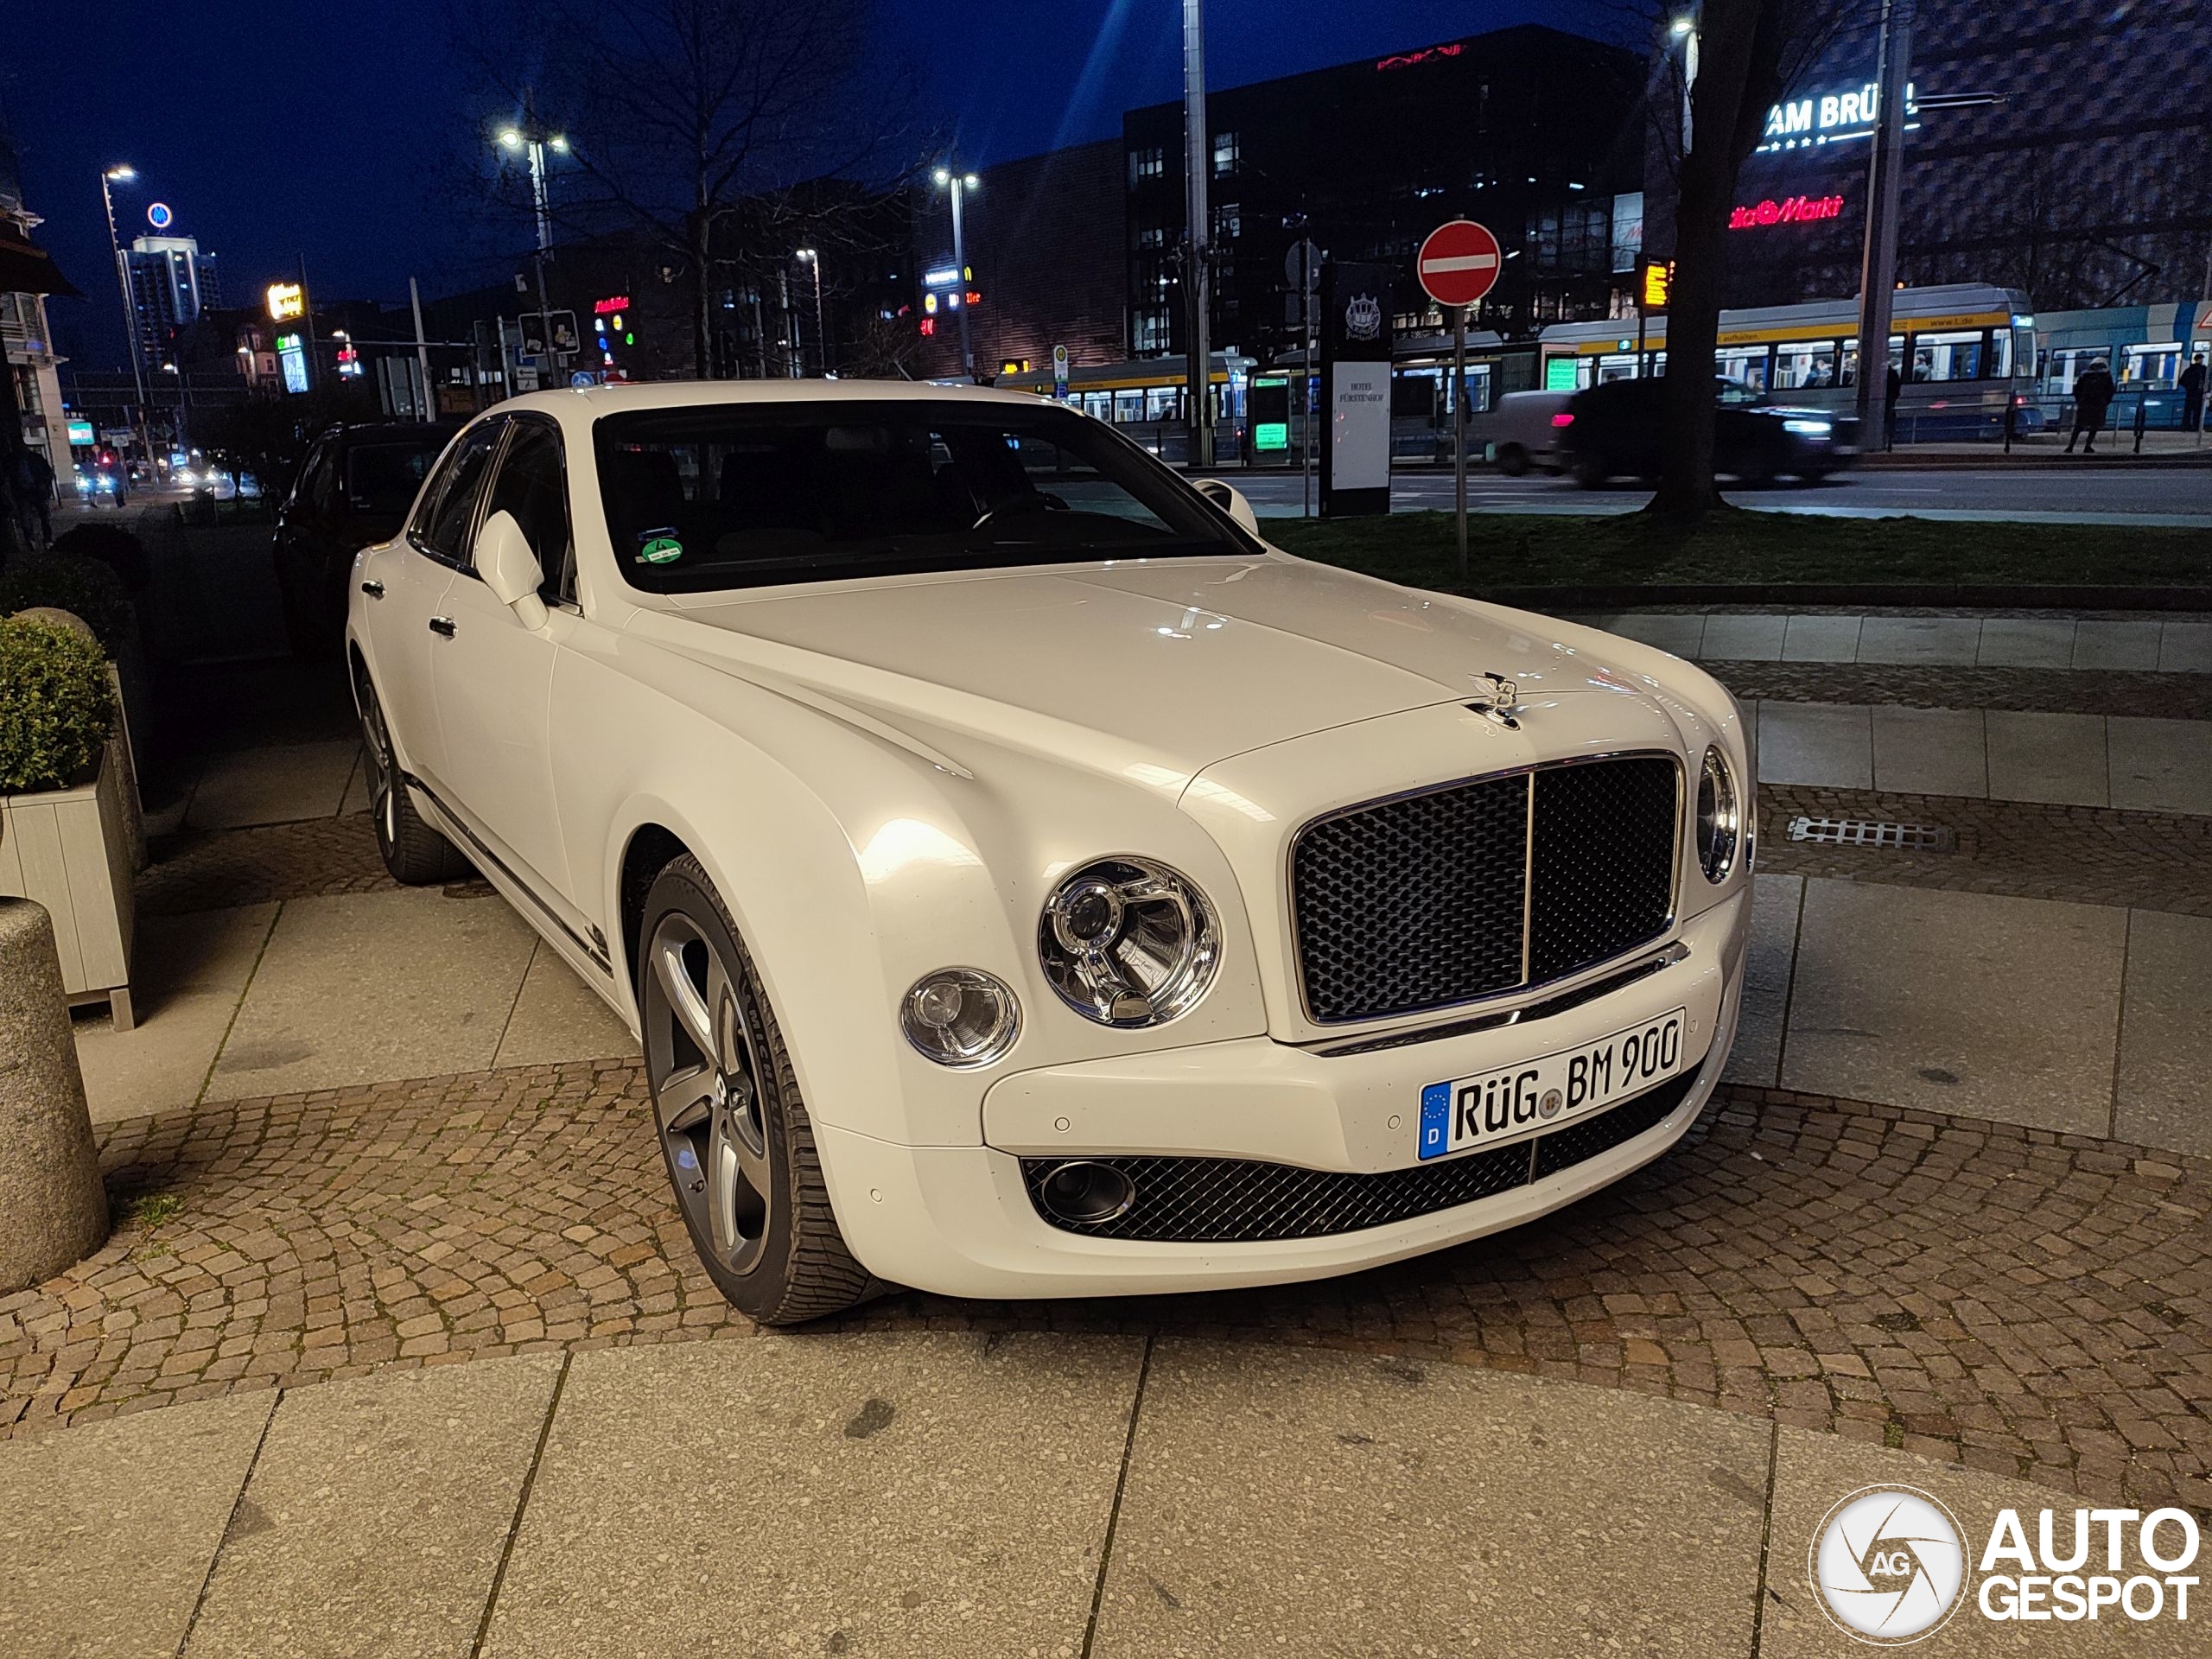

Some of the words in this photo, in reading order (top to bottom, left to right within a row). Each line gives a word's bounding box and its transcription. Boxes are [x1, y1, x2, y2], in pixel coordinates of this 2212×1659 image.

[1765, 99, 1814, 137] AM
[1820, 83, 1918, 129] BRÜL
[1351, 383, 1372, 391] HOTEL
[1339, 392, 1384, 404] FÜRSTENHOF
[1454, 1069, 1539, 1141] RÜG
[1566, 1043, 1613, 1110] BM
[1620, 1019, 1679, 1089] 900
[1427, 1127, 1440, 1146] D
